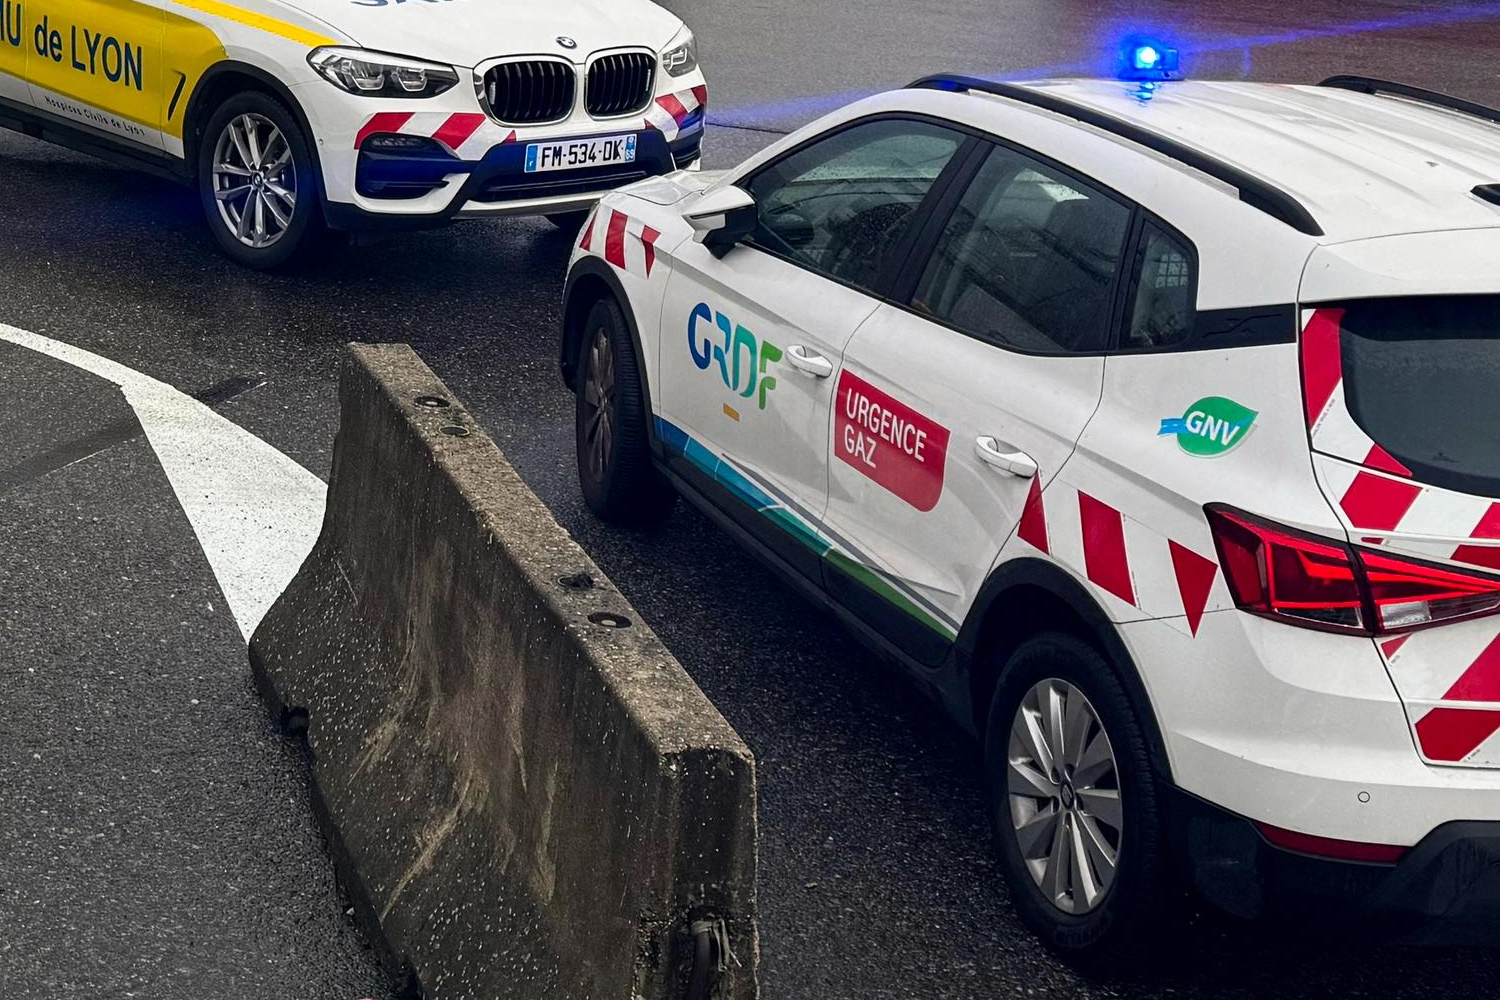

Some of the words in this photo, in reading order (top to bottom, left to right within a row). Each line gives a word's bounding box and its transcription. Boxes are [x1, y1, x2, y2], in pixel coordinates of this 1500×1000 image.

[34, 15, 63, 63] de
[70, 25, 143, 91] LYON
[541, 140, 623, 168] FM-534-DK
[687, 302, 784, 410] GRDF
[844, 424, 877, 468] GAZ
[846, 388, 927, 462] URGENCE
[1186, 411, 1240, 446] GNV
